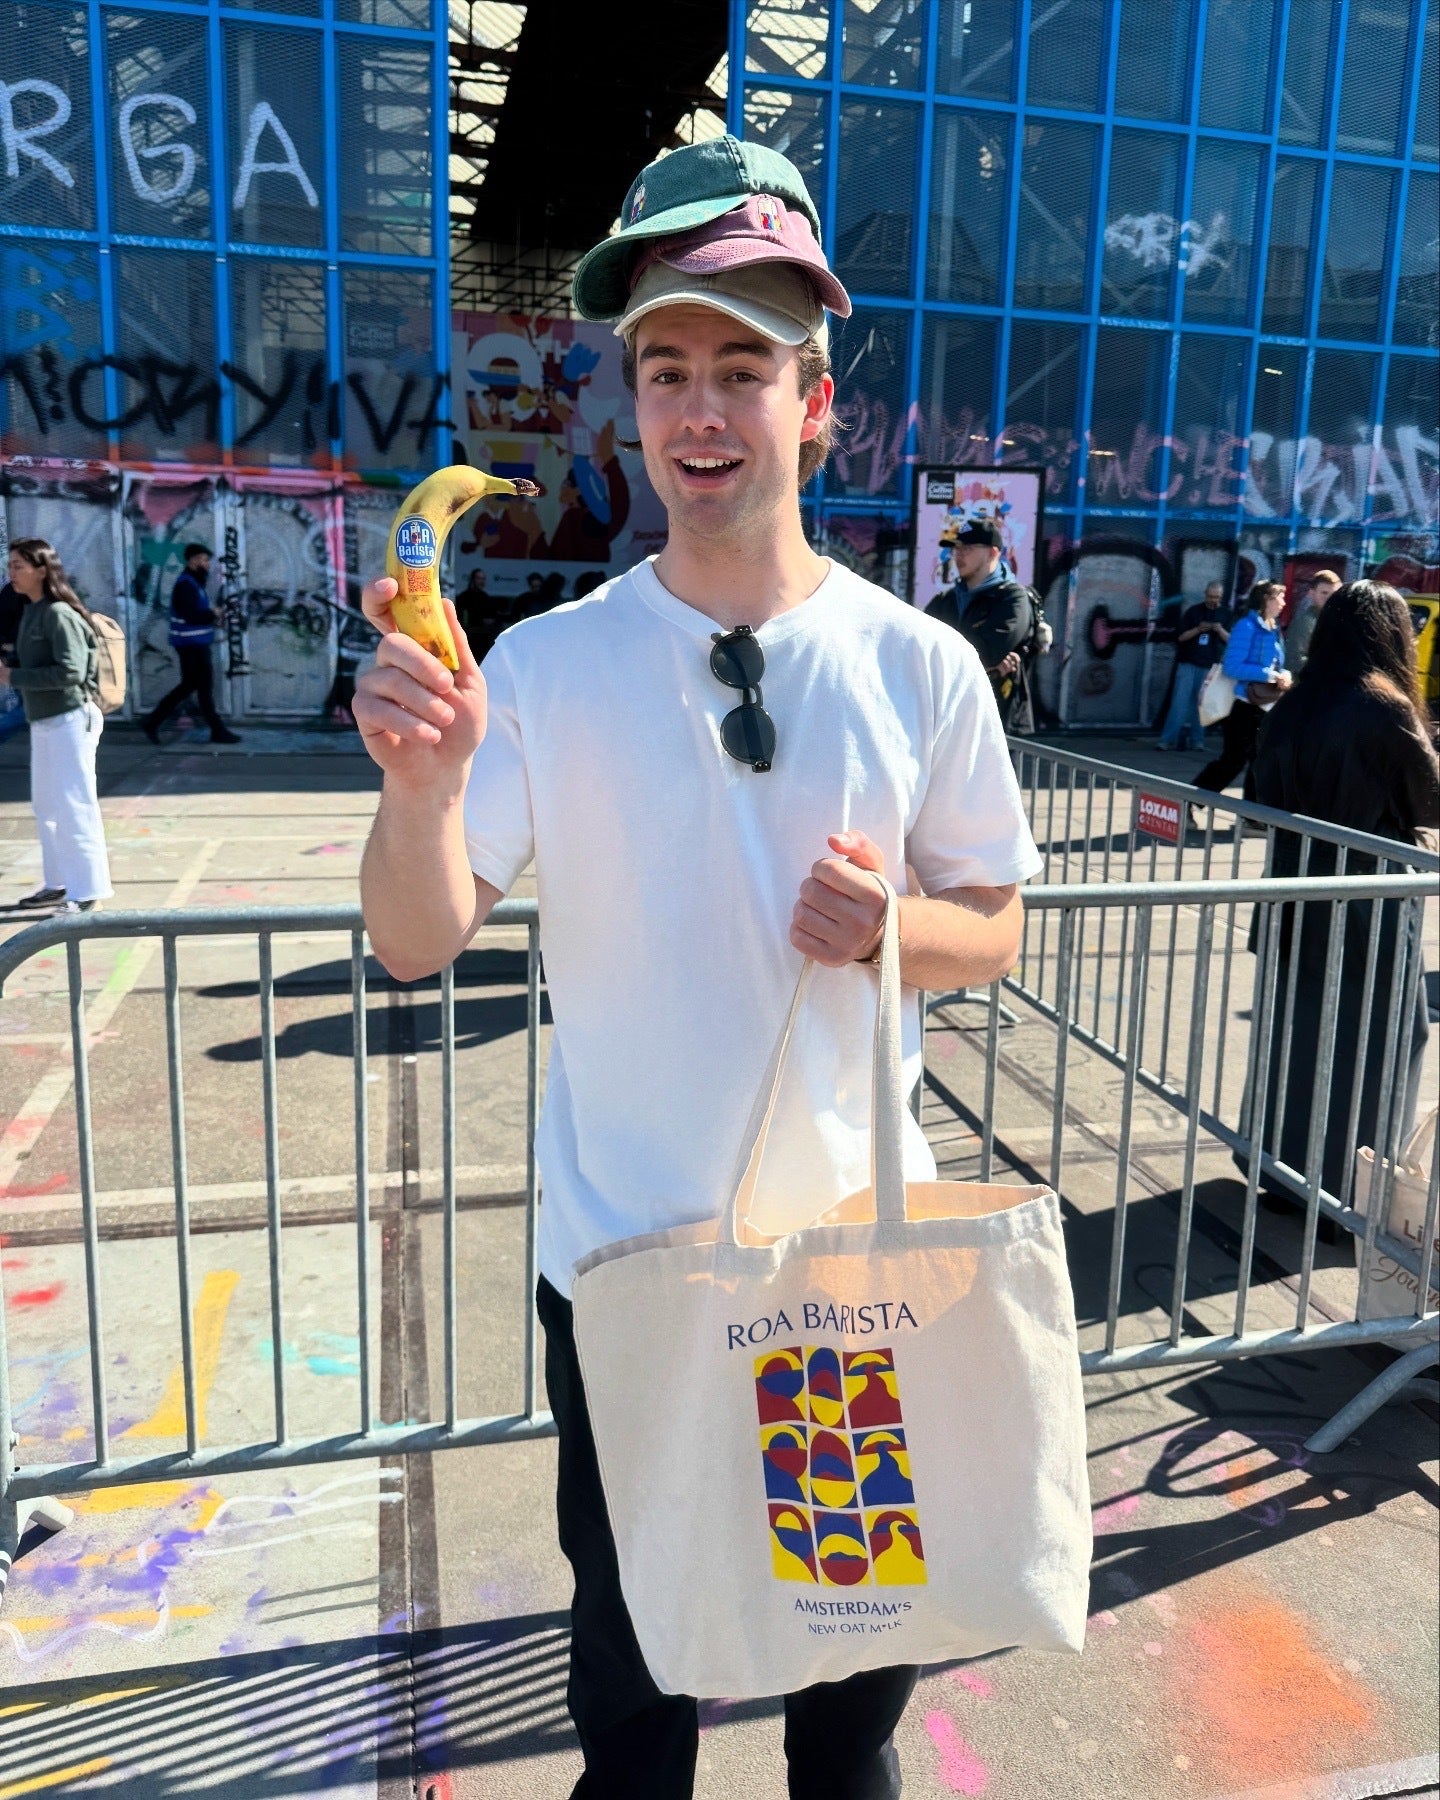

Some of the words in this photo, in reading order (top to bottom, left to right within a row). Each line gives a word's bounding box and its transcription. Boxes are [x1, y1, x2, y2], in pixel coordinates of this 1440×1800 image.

[402, 525, 430, 544] RA
[398, 543, 434, 557] Barista
[1140, 799, 1178, 824] LOXAM
[1404, 1219, 1439, 1251] Lie
[727, 1309, 794, 1350] ROA
[803, 1301, 919, 1335] BARISTA
[808, 1623, 837, 1635] NEW
[840, 1623, 866, 1634] OAT
